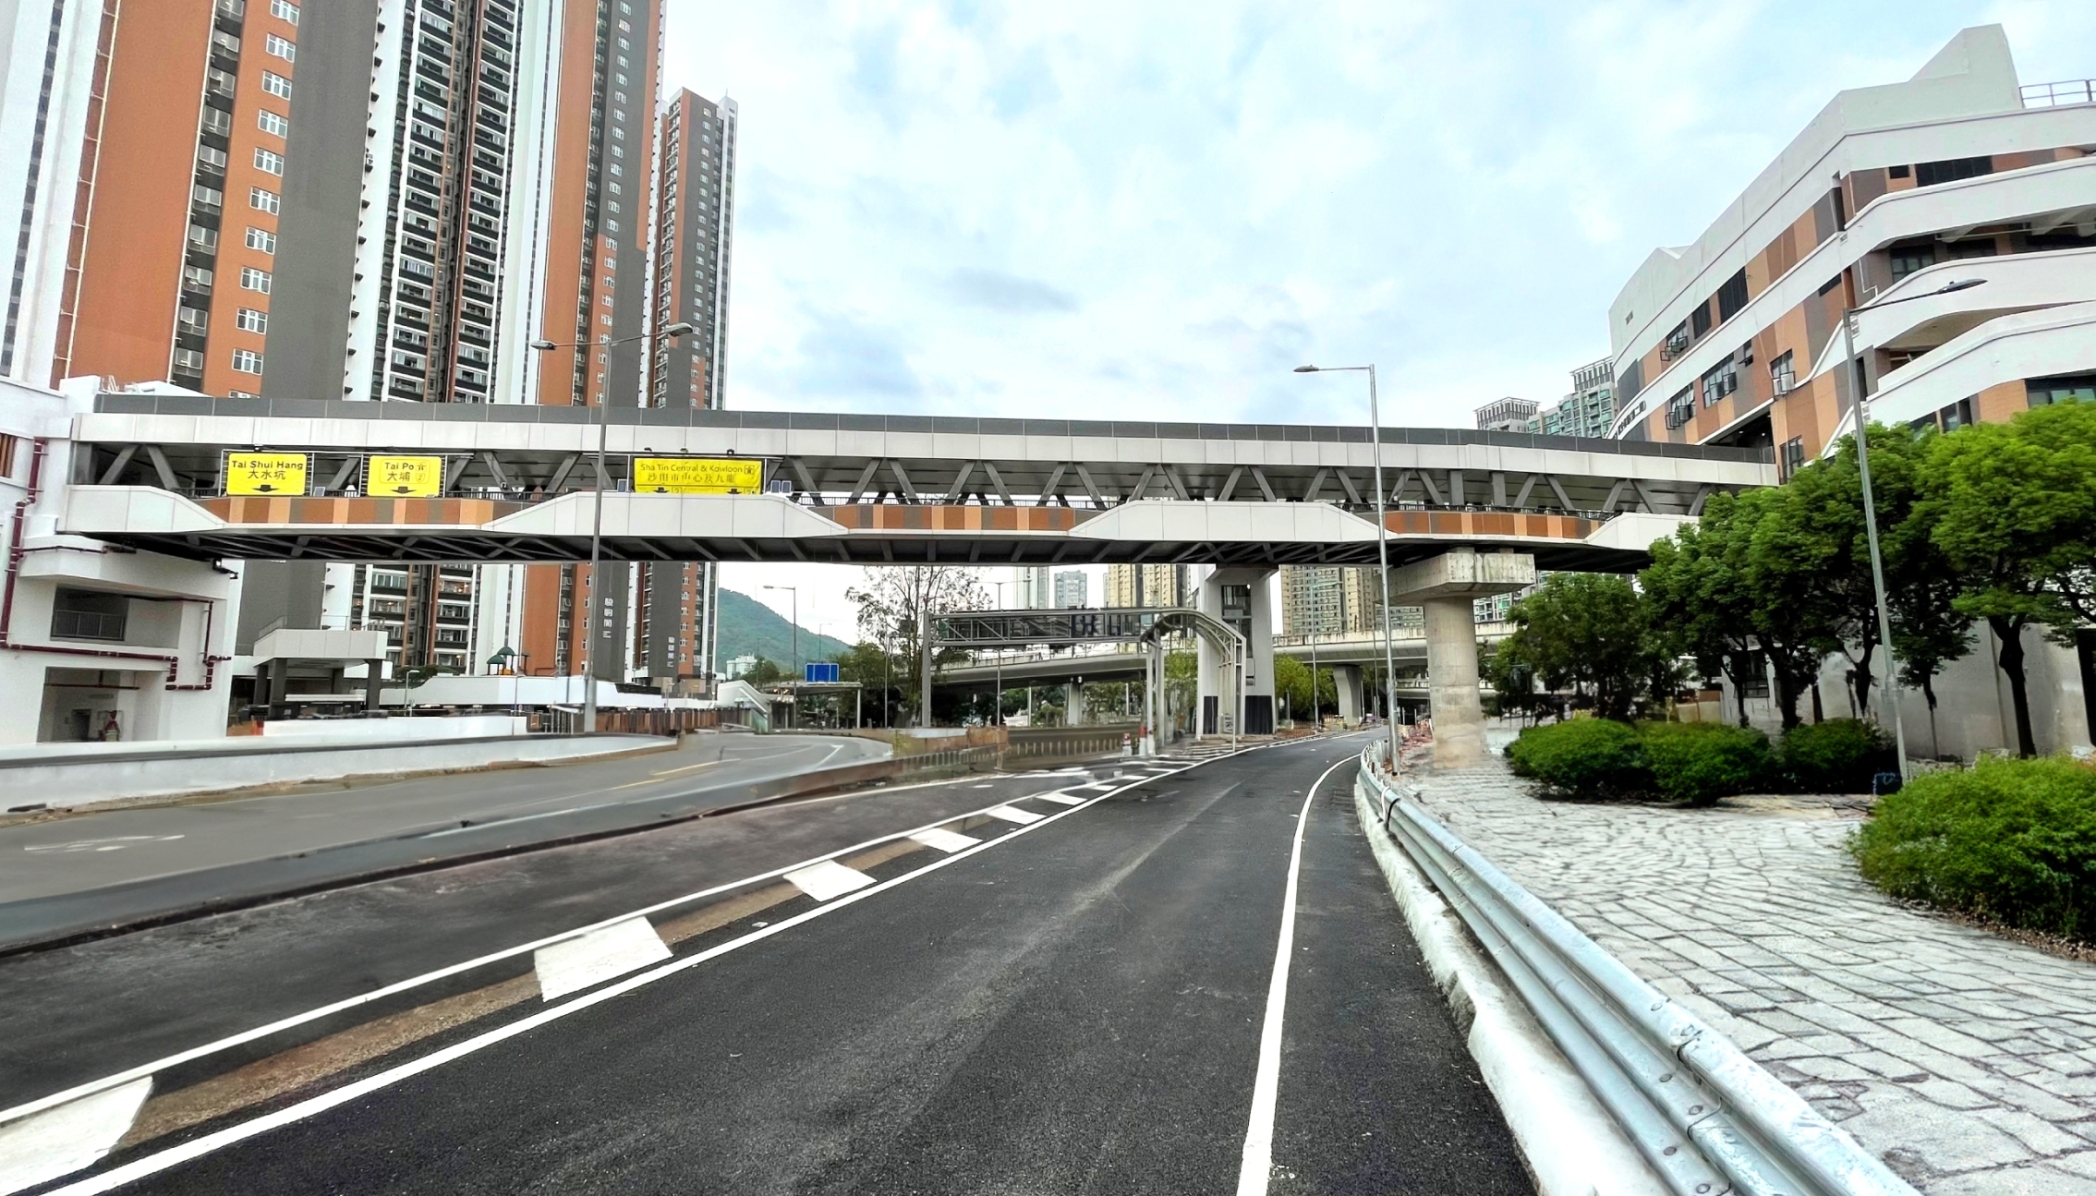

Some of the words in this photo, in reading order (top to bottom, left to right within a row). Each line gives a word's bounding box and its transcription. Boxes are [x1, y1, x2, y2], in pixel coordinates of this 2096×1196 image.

[232, 460, 247, 469] Tai
[250, 460, 273, 469] Shui
[277, 460, 304, 471] Hang
[385, 462, 399, 470] Tai
[402, 462, 414, 470] Po
[640, 463, 656, 471] Sha
[657, 463, 669, 471] Tin
[670, 464, 699, 472] Central
[709, 465, 743, 473] Kowloon
[247, 469, 287, 480] 大水坑
[387, 471, 411, 482] 大埔
